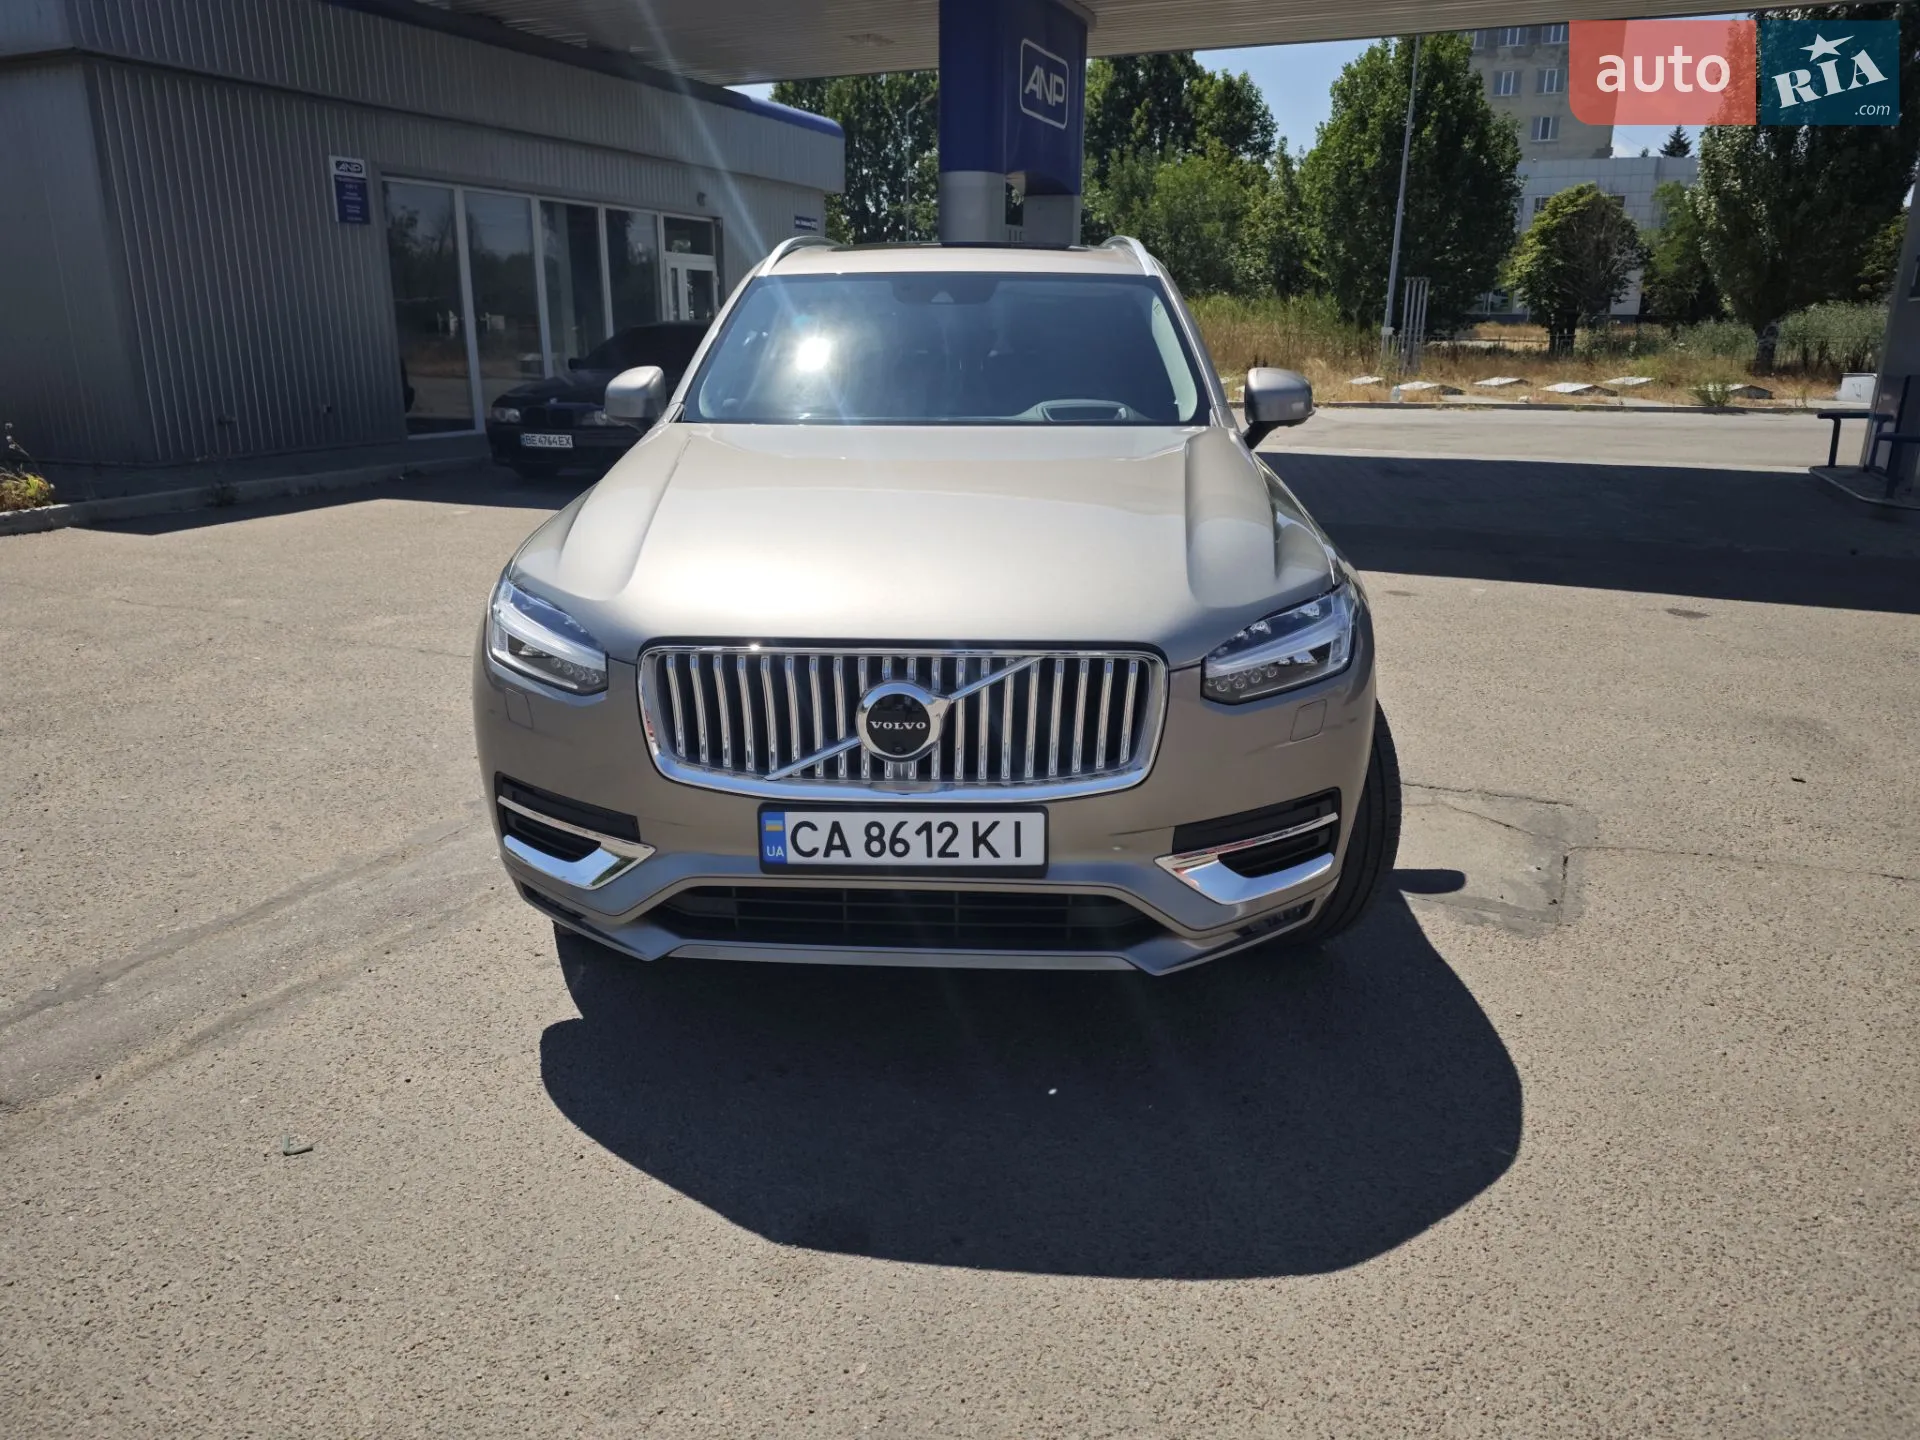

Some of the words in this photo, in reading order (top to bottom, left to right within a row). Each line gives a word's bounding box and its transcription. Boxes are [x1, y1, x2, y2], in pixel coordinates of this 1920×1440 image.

[1024, 65, 1066, 107] ANP
[869, 720, 927, 731] VOLVO
[766, 845, 785, 858] UA
[790, 820, 852, 859] CA
[863, 821, 960, 859] 8612
